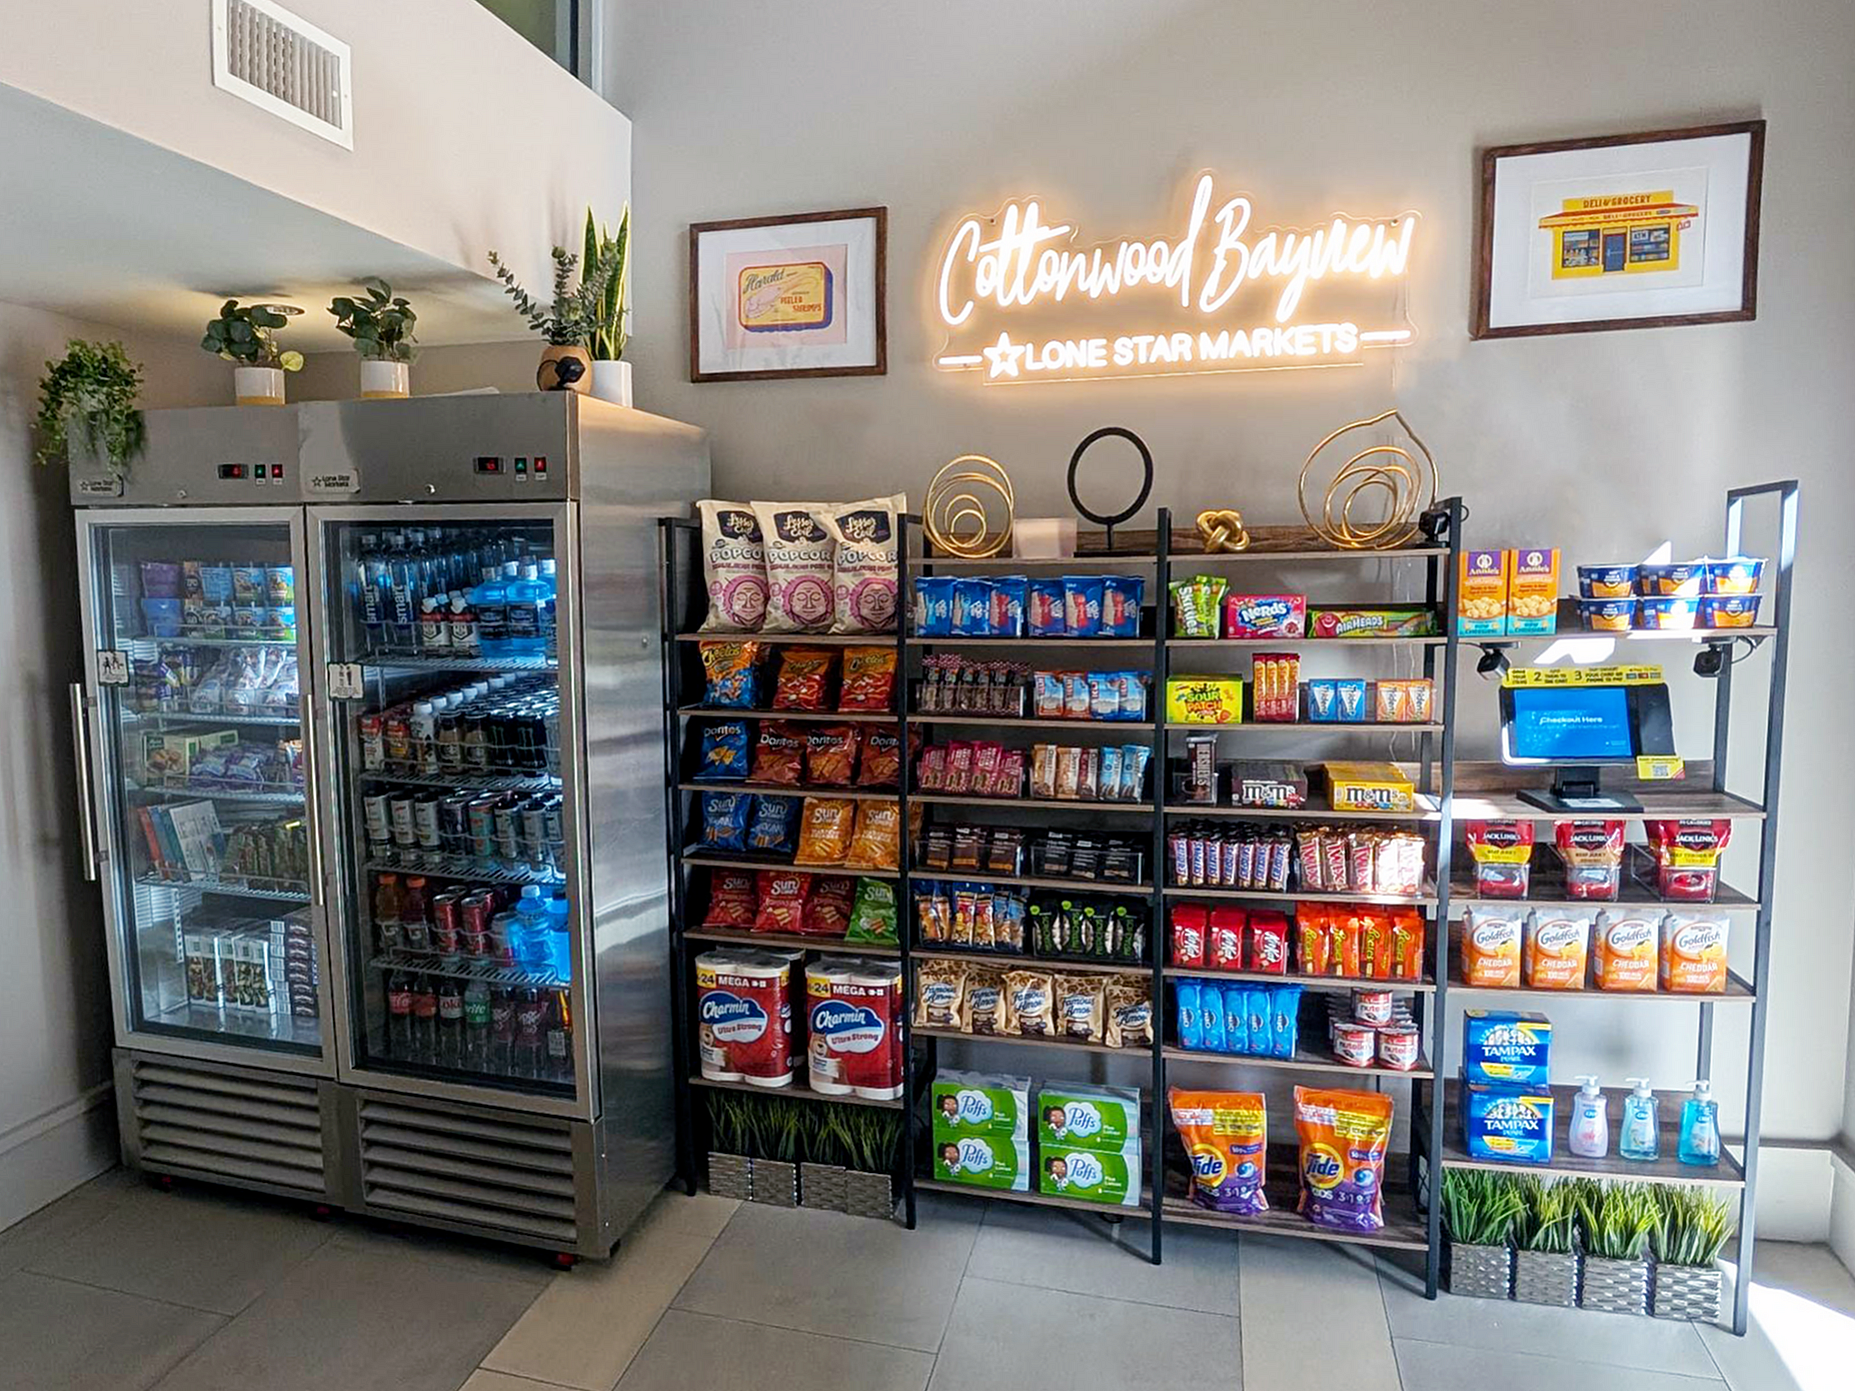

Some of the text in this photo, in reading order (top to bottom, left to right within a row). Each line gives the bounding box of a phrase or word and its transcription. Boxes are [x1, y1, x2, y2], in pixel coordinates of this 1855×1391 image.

[1583, 199, 1602, 209] DELI
[939, 175, 1415, 325] Cottonwood Bayview
[1024, 322, 1359, 370] LONE STAR MARKETS
[710, 549, 763, 563] POPCO
[769, 549, 832, 564] POPCOR
[364, 585, 378, 624] smart
[394, 584, 408, 625] smart
[1336, 616, 1384, 636] AIRHEADS
[1534, 672, 1542, 682] 2
[1574, 671, 1582, 681] 3
[1185, 690, 1220, 701] SOUR
[1185, 700, 1223, 713] PATCH
[1540, 715, 1580, 725] Checkout
[703, 724, 742, 738] Doritos
[760, 733, 799, 748] Doritos
[708, 799, 735, 813] Sun
[759, 802, 787, 818] Sun
[812, 807, 842, 824] Sun
[866, 809, 895, 824] Sun
[770, 880, 800, 895] Sun
[1477, 929, 1515, 944] Goldfish
[1540, 929, 1580, 945] Goldfish
[1611, 929, 1652, 945] Goldfish
[1679, 932, 1721, 948] Goldfish
[1478, 958, 1513, 967] CHEDDAR
[1541, 959, 1577, 968] CHEDDAR
[1612, 959, 1649, 969] CHEDDAR
[1680, 962, 1718, 972] CHEDDAR
[700, 972, 750, 988] 24 MEGA
[814, 980, 866, 997] 24 MEGA
[702, 1001, 750, 1019] Charmin
[815, 1010, 866, 1030] Charmin
[717, 1022, 763, 1035] Ultra Strong
[831, 1033, 879, 1045] Ultra Strong
[1482, 1046, 1537, 1056] TAMPAX
[961, 1095, 987, 1117] Puffs
[1069, 1107, 1095, 1129] Puffs
[1484, 1120, 1539, 1130] TAMPAX
[962, 1144, 988, 1166] Puffs
[1070, 1158, 1097, 1180] Puffs
[1306, 1153, 1340, 1176] Tide
